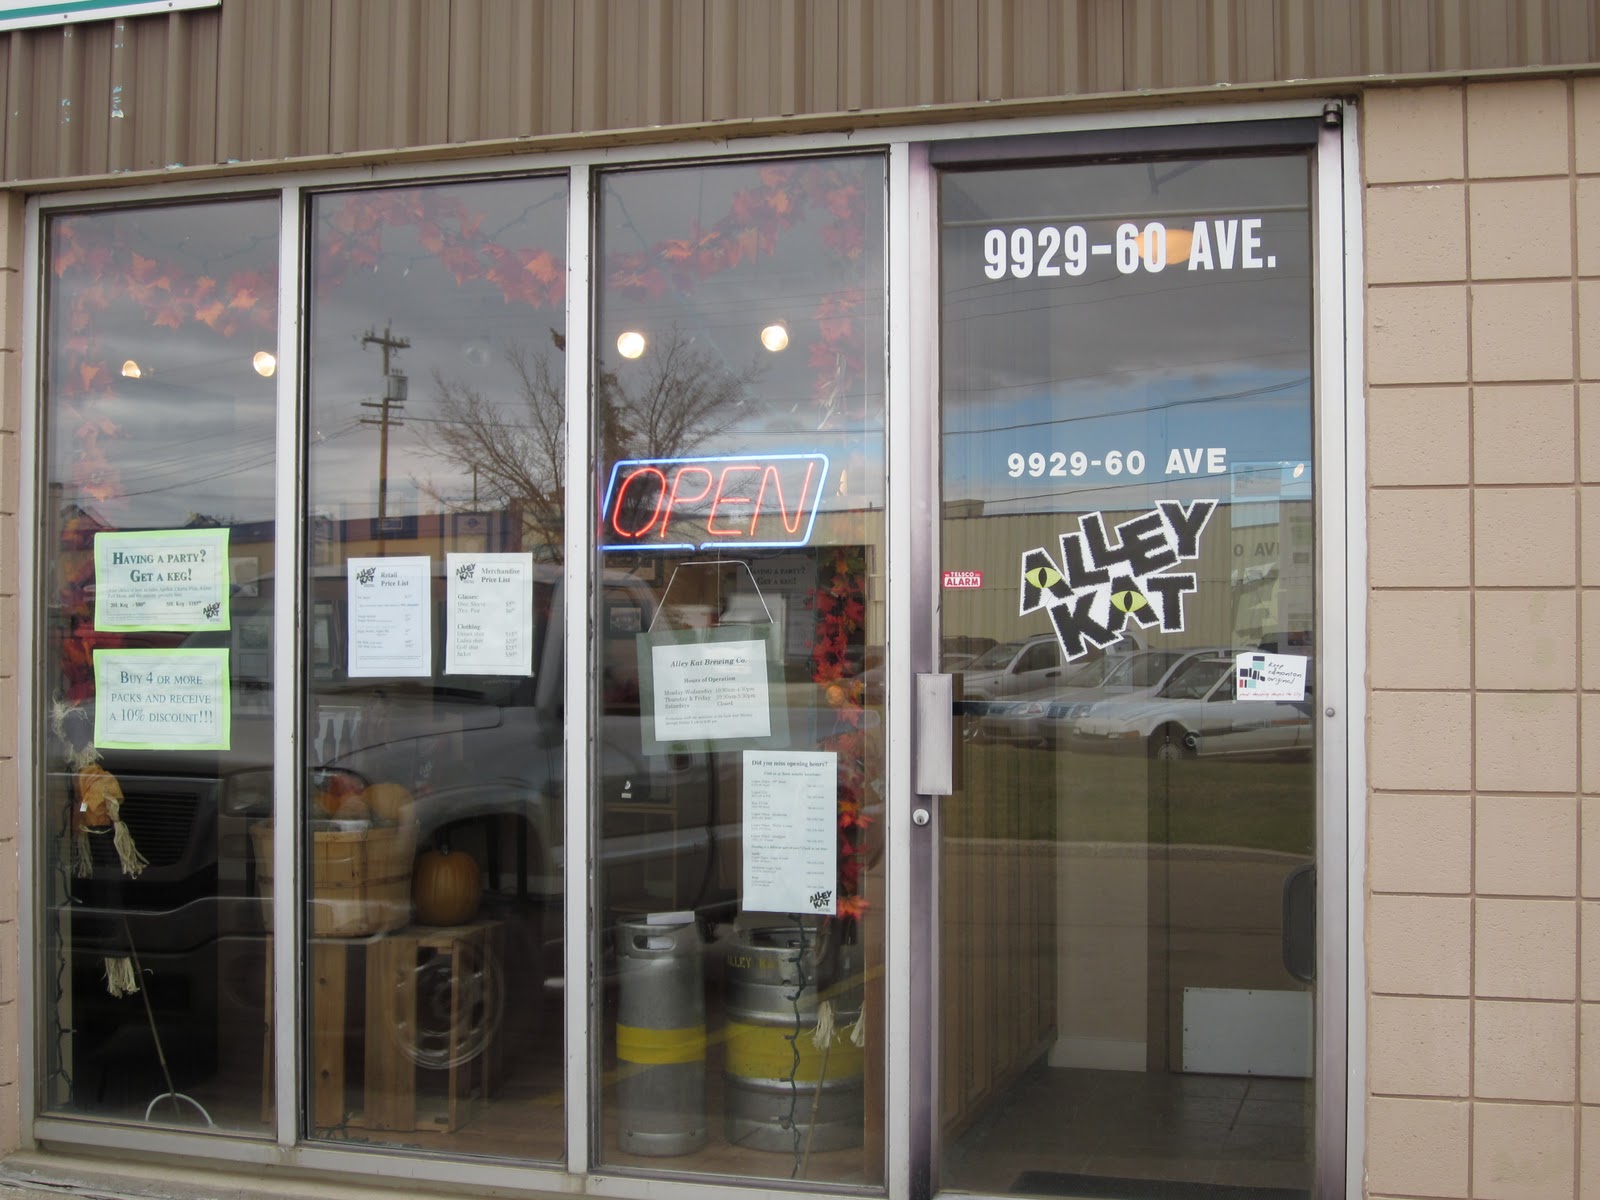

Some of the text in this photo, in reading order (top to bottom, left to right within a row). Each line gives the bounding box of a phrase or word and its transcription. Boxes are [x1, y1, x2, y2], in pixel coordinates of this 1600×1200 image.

[984, 218, 1276, 280] 9929-60 AVE.
[1007, 448, 1227, 478] 9929-60 AVE
[612, 461, 814, 539] OPEN
[112, 549, 206, 565] HAVING A PARTY?
[1019, 498, 1219, 617] ALLEY
[130, 568, 192, 582] GET A KEG!
[356, 567, 376, 580] ALLEY
[456, 563, 476, 576] ALLEY
[459, 571, 474, 581] KAT
[359, 575, 375, 586] KAT
[946, 577, 979, 586] ALARM
[1047, 572, 1197, 662] KAT
[670, 660, 688, 668] Alley
[705, 658, 734, 666] Brewing
[120, 671, 203, 685] BUY 4 OR MORE
[111, 693, 211, 704] PACKS AND RECEIVE
[109, 708, 213, 723] A 10% DISCOUNT!!!
[810, 890, 832, 903] ALLEY
[813, 899, 830, 909] KAT
